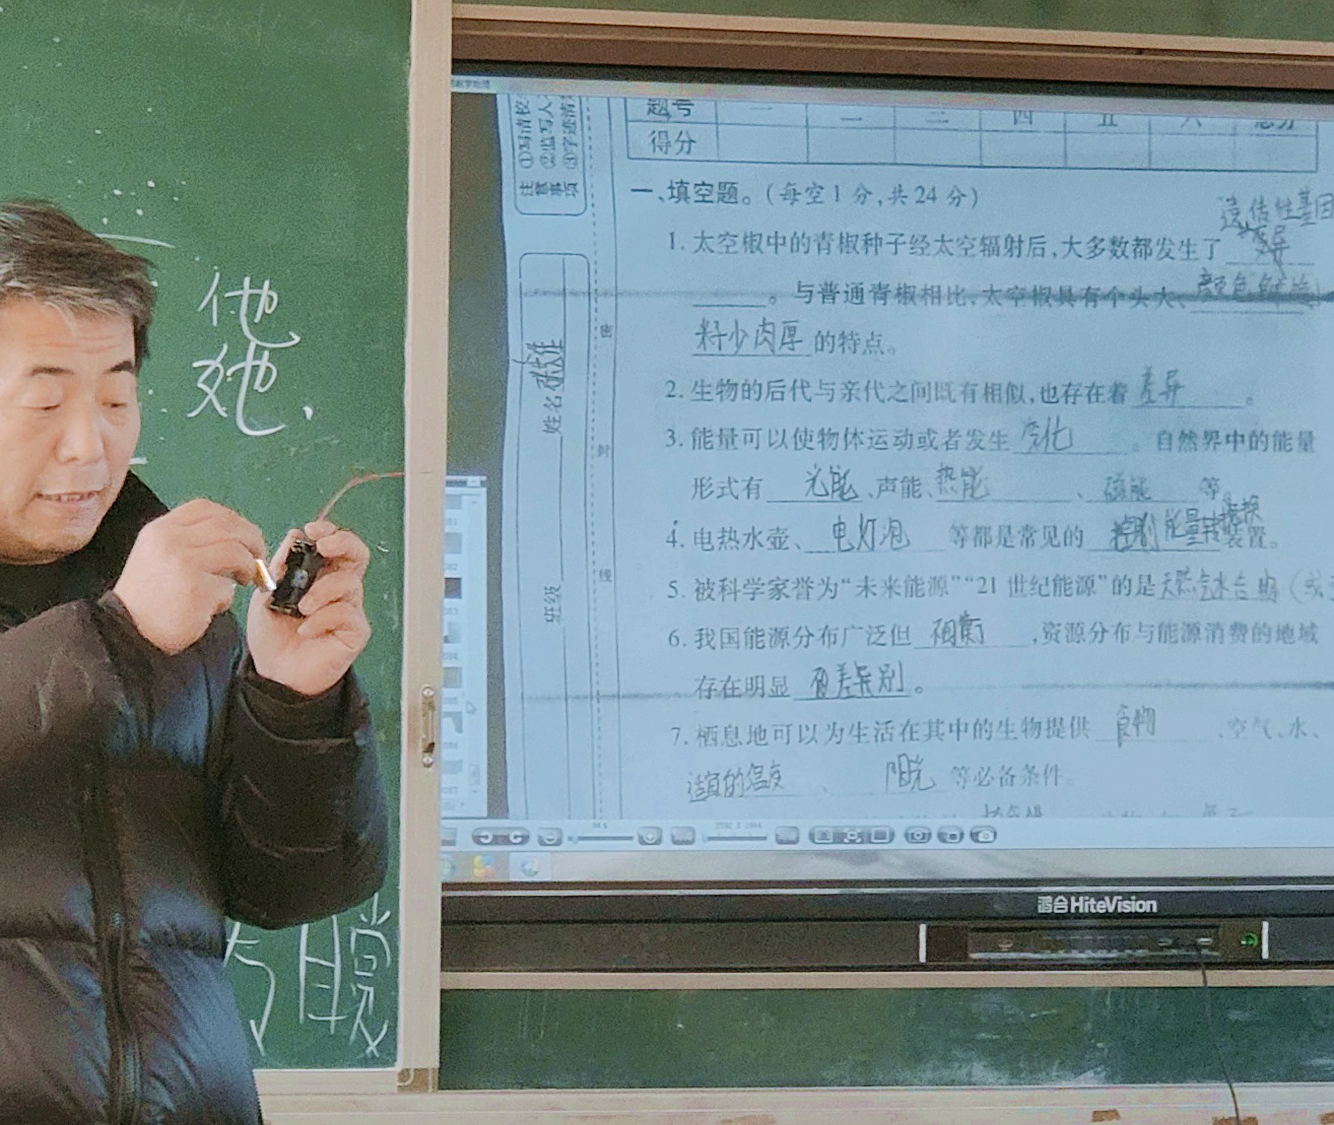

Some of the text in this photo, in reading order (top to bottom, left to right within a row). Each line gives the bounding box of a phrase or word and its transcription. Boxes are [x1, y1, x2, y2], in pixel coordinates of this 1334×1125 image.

[650, 129, 696, 155] 得分
[694, 624, 912, 650] 我国能源分布广泛但
